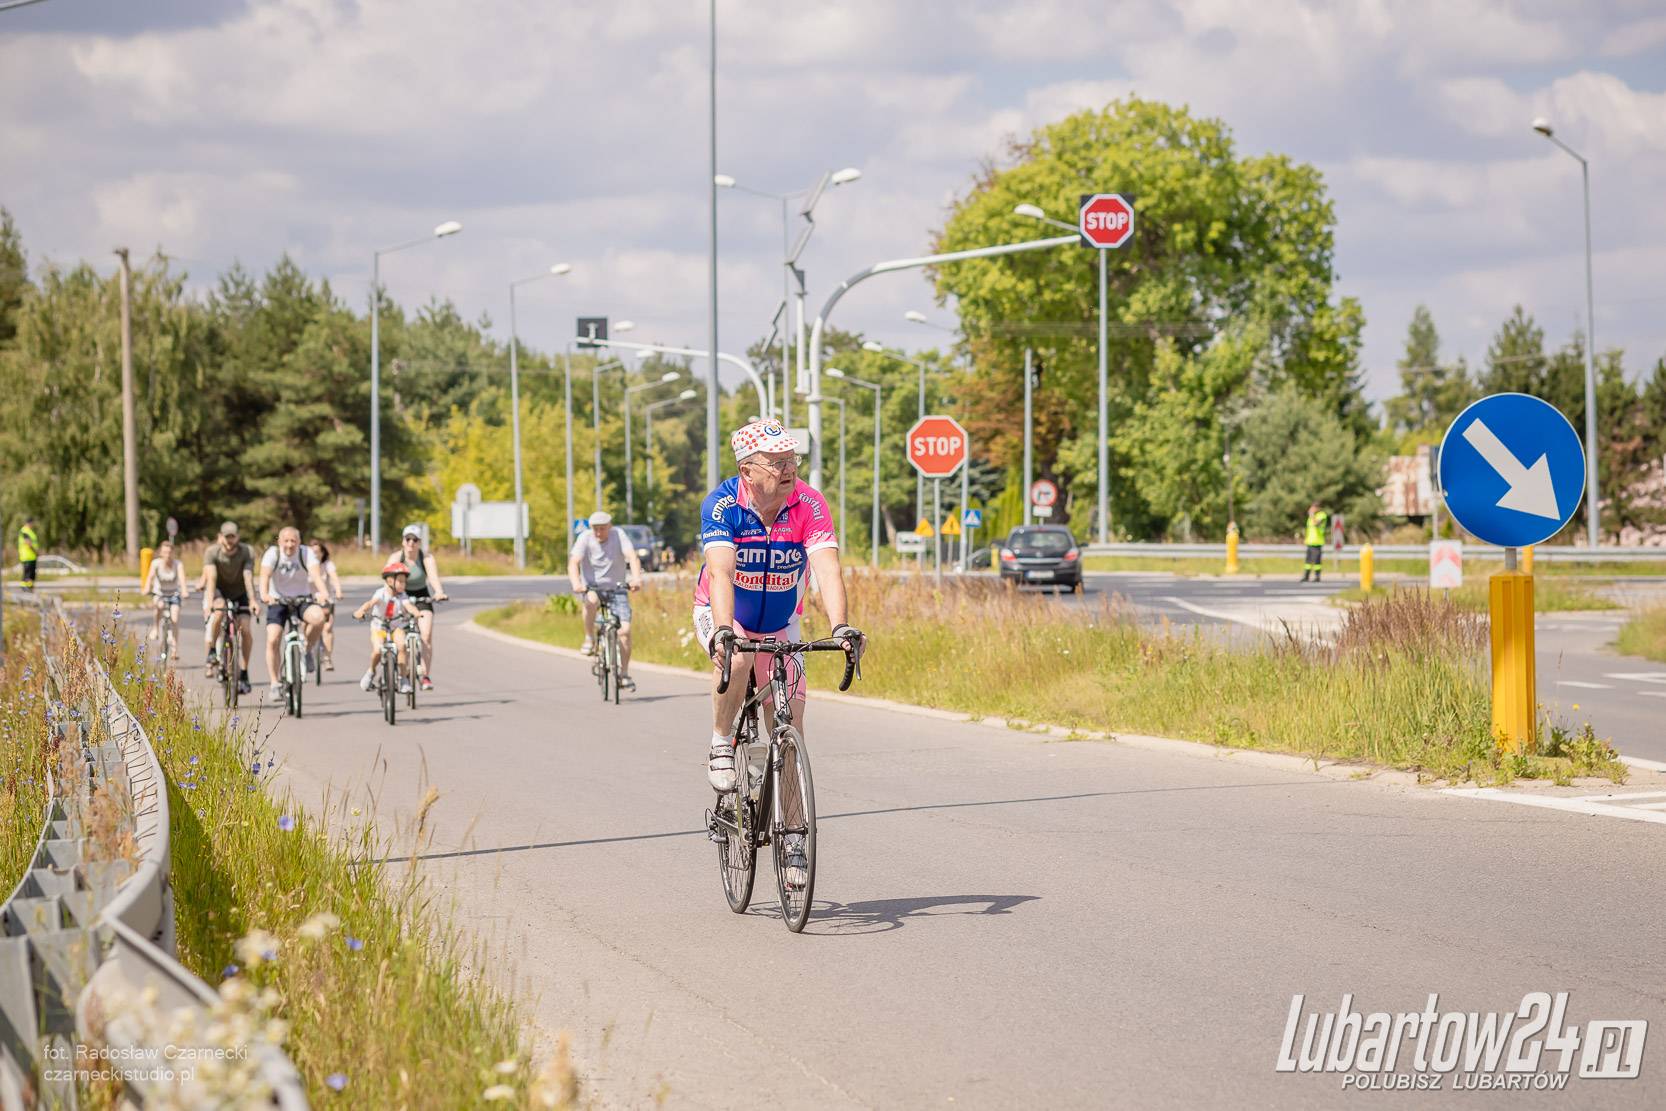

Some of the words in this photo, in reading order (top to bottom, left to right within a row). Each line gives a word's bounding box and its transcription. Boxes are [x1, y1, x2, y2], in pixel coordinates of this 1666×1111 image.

[1086, 211, 1129, 231] STOP
[913, 436, 962, 457] STOP
[711, 494, 736, 521] ampre
[735, 548, 802, 569] ampre
[735, 571, 795, 586] fondital
